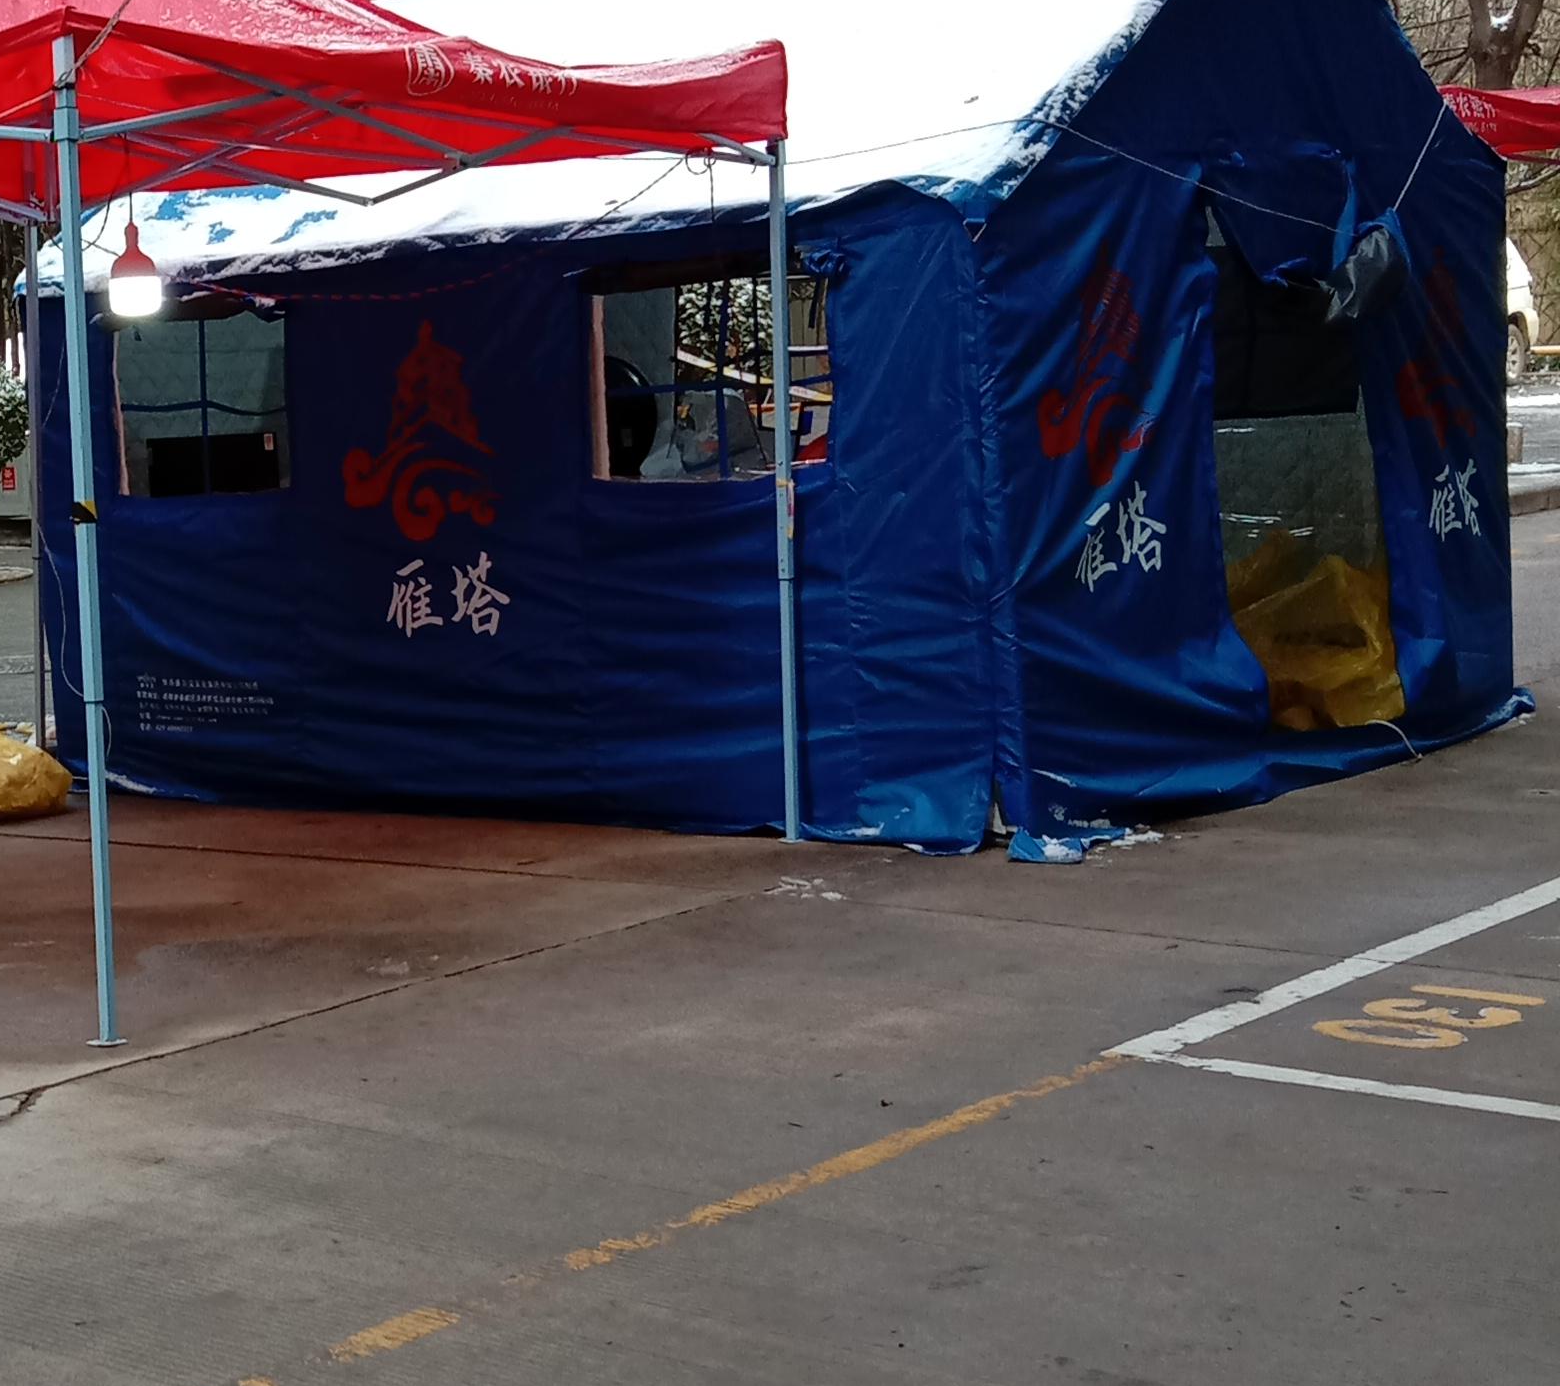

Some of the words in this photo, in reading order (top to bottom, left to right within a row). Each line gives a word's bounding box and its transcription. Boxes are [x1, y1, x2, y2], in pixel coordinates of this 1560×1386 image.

[1075, 480, 1167, 593] 雁塔
[1429, 458, 1481, 543] 雁塔
[386, 550, 511, 638] 雁塔
